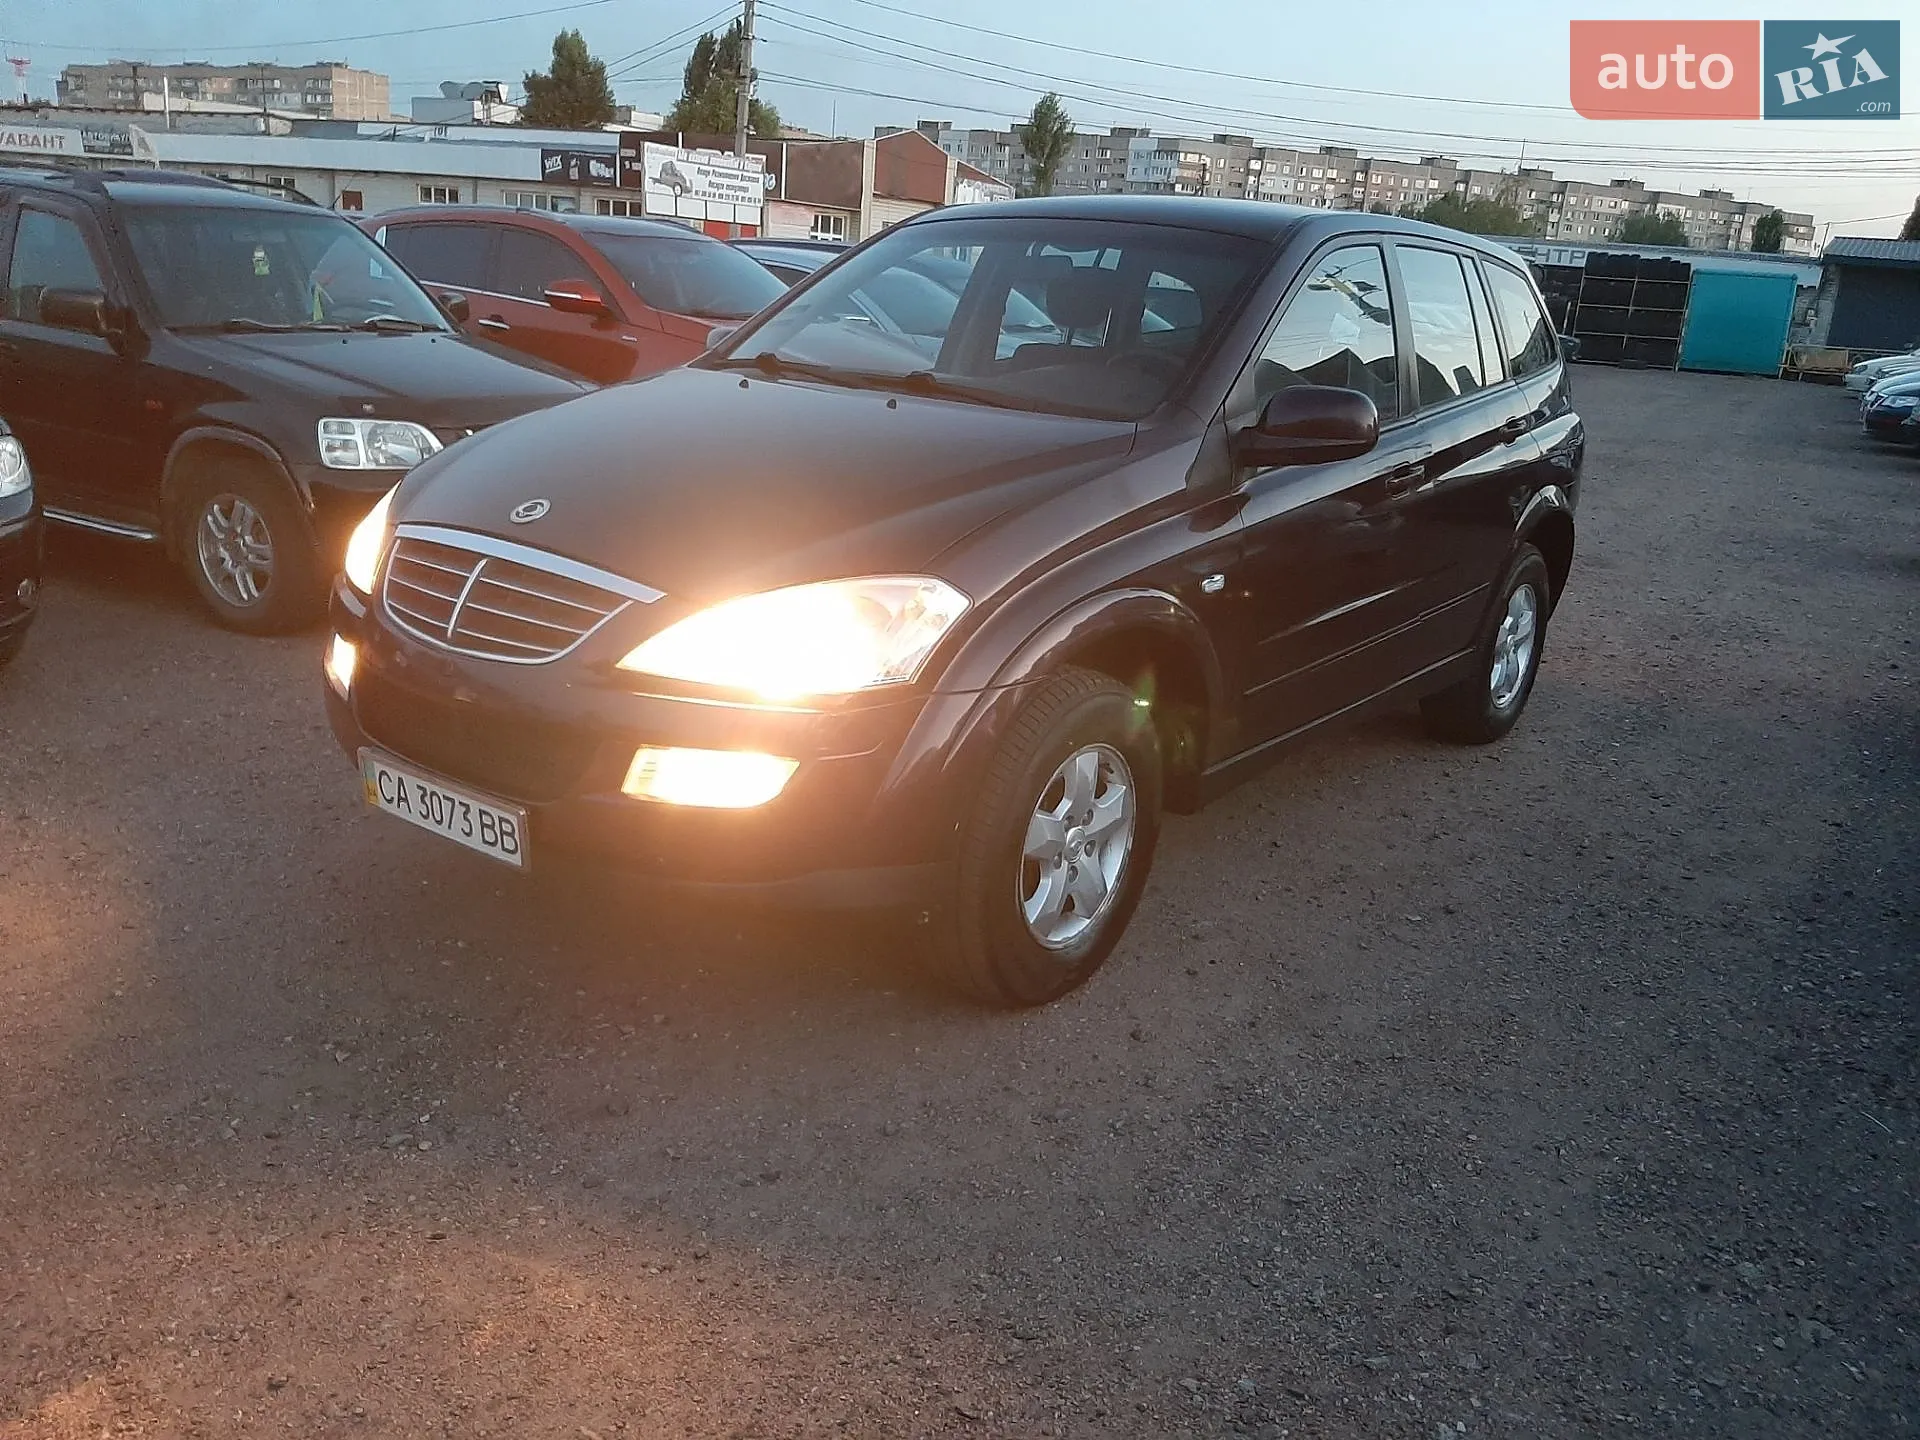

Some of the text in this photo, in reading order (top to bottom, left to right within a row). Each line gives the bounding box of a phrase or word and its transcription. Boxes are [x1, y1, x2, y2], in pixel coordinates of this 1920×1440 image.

[378, 770, 519, 855] CA 3073 BB
